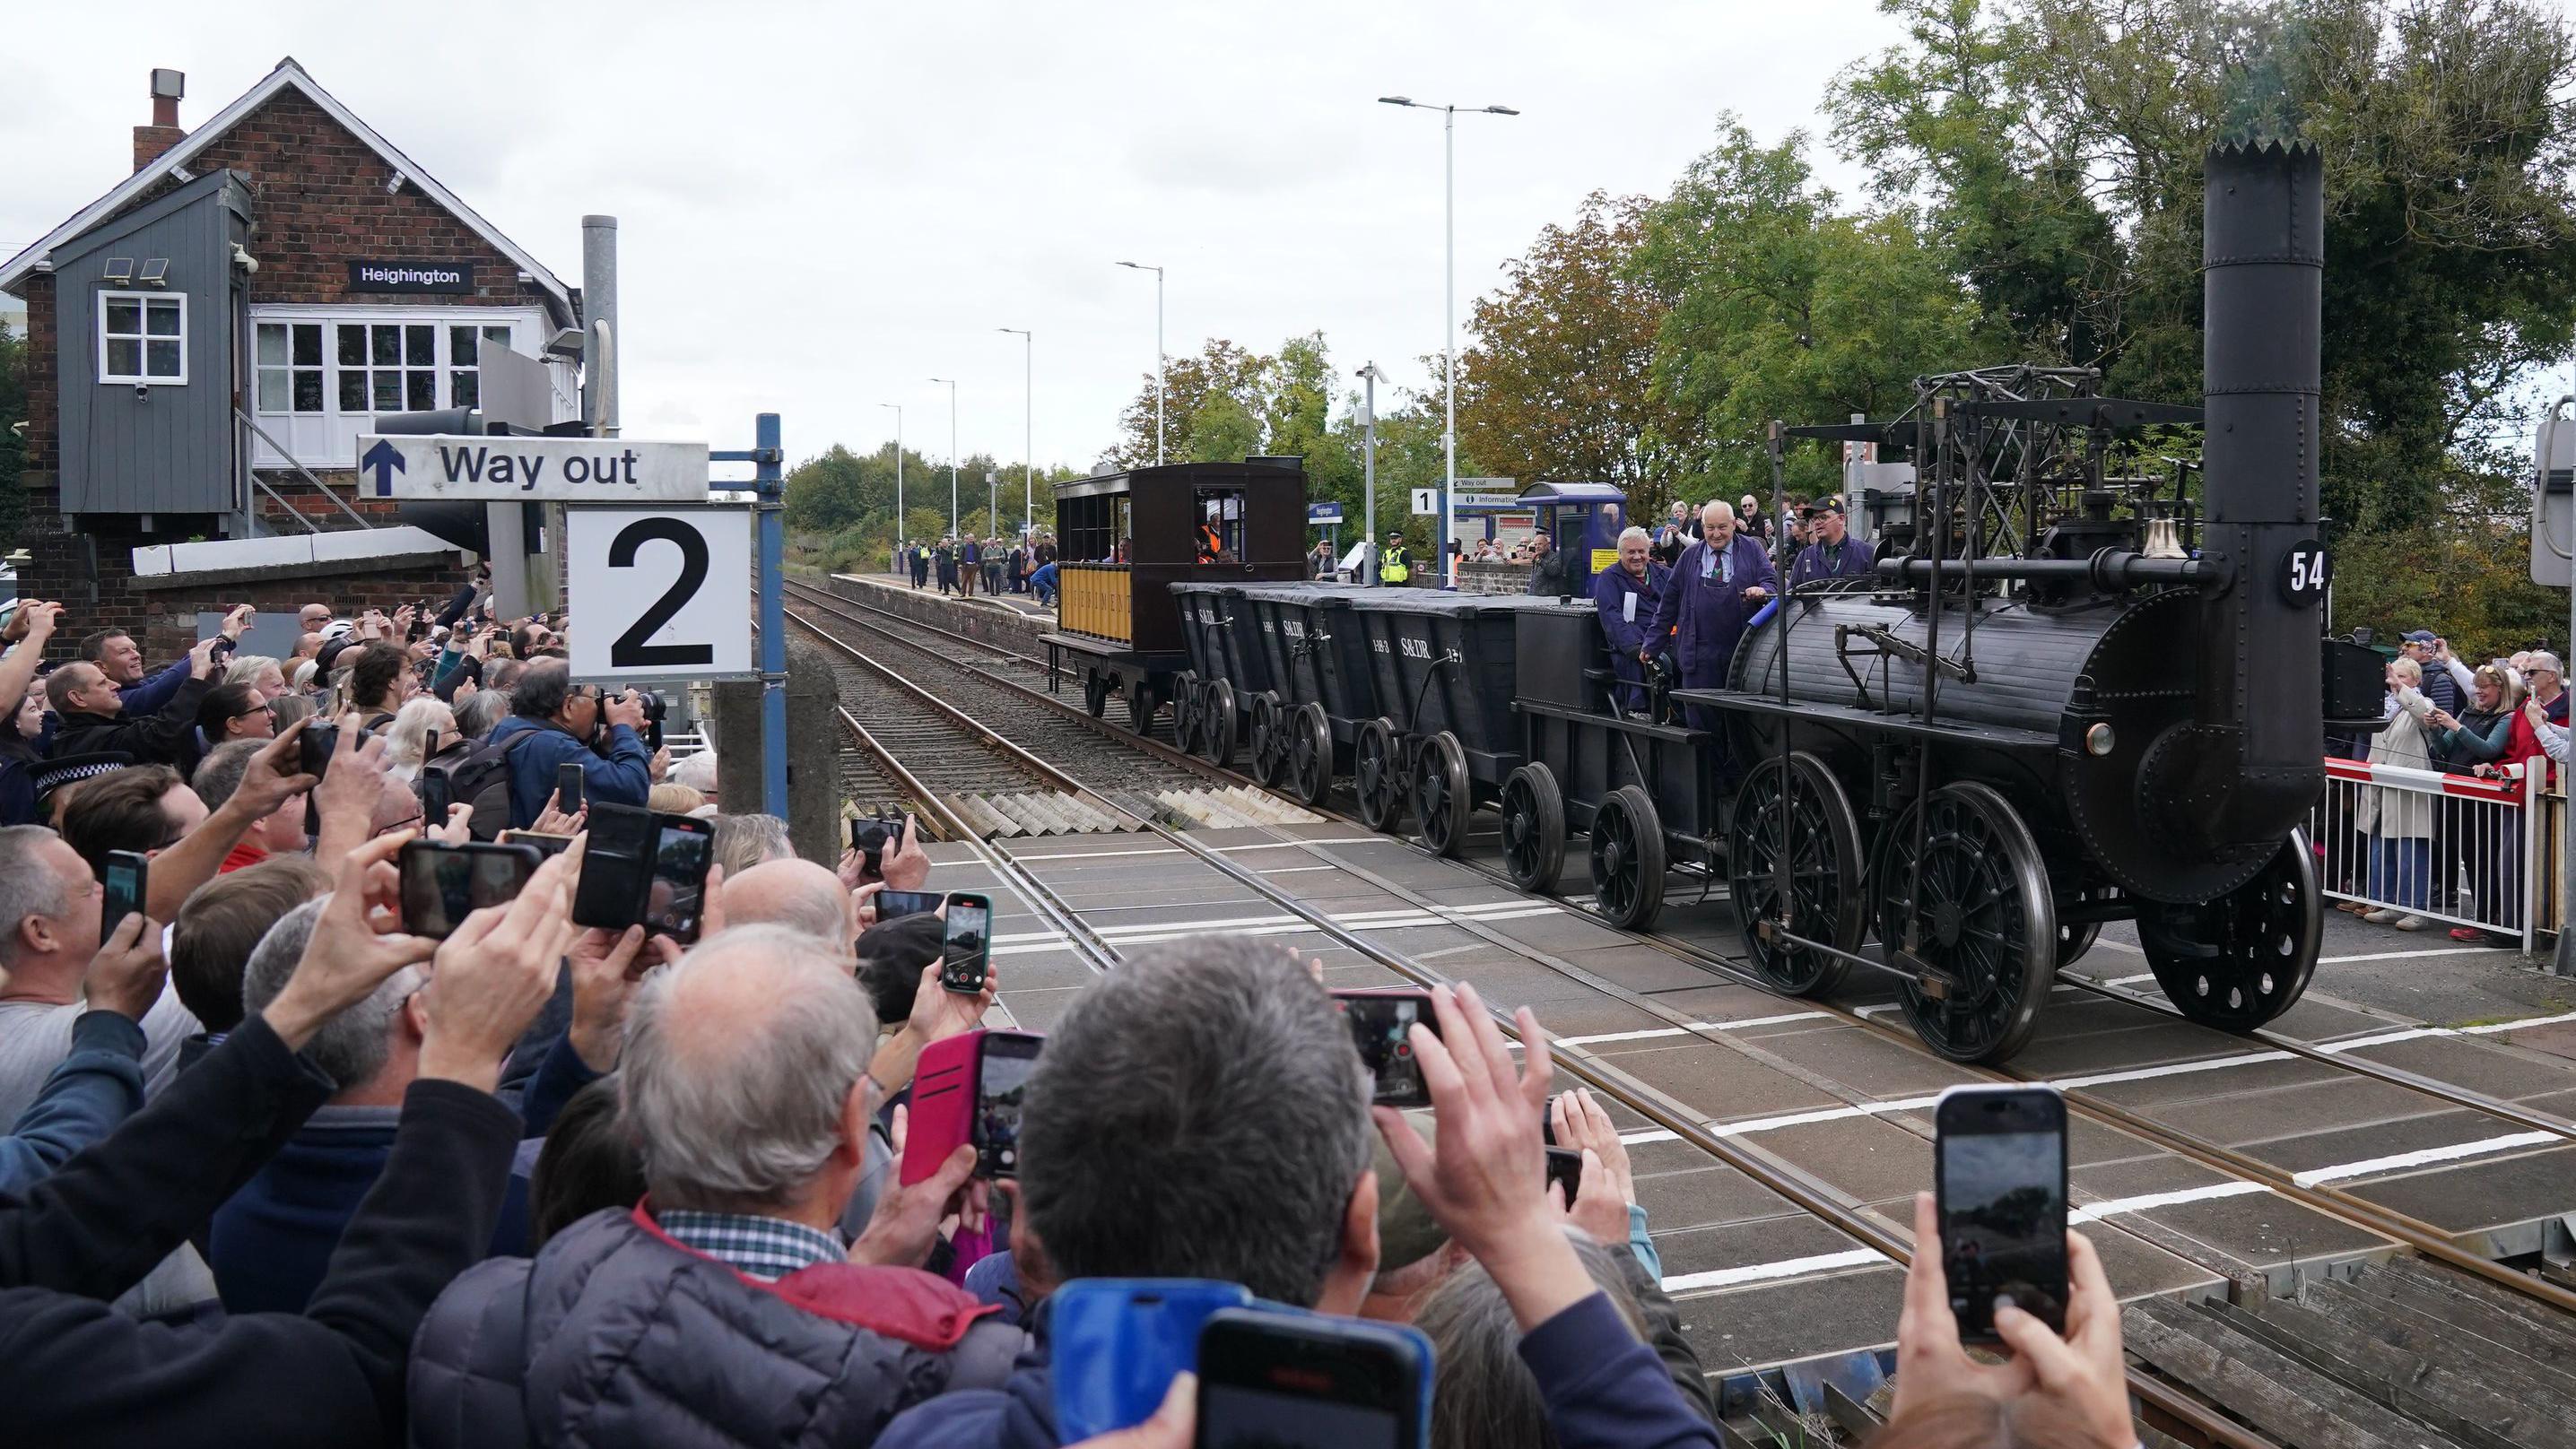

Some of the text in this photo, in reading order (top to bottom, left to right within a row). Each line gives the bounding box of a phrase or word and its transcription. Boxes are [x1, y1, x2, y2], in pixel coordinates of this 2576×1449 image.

[361, 267, 460, 285] Heighington
[439, 447, 638, 491] Way out
[1420, 492, 1428, 510] 1
[2291, 551, 2325, 591] 54
[608, 516, 714, 668] 2
[1400, 637, 1432, 659] S&DR
